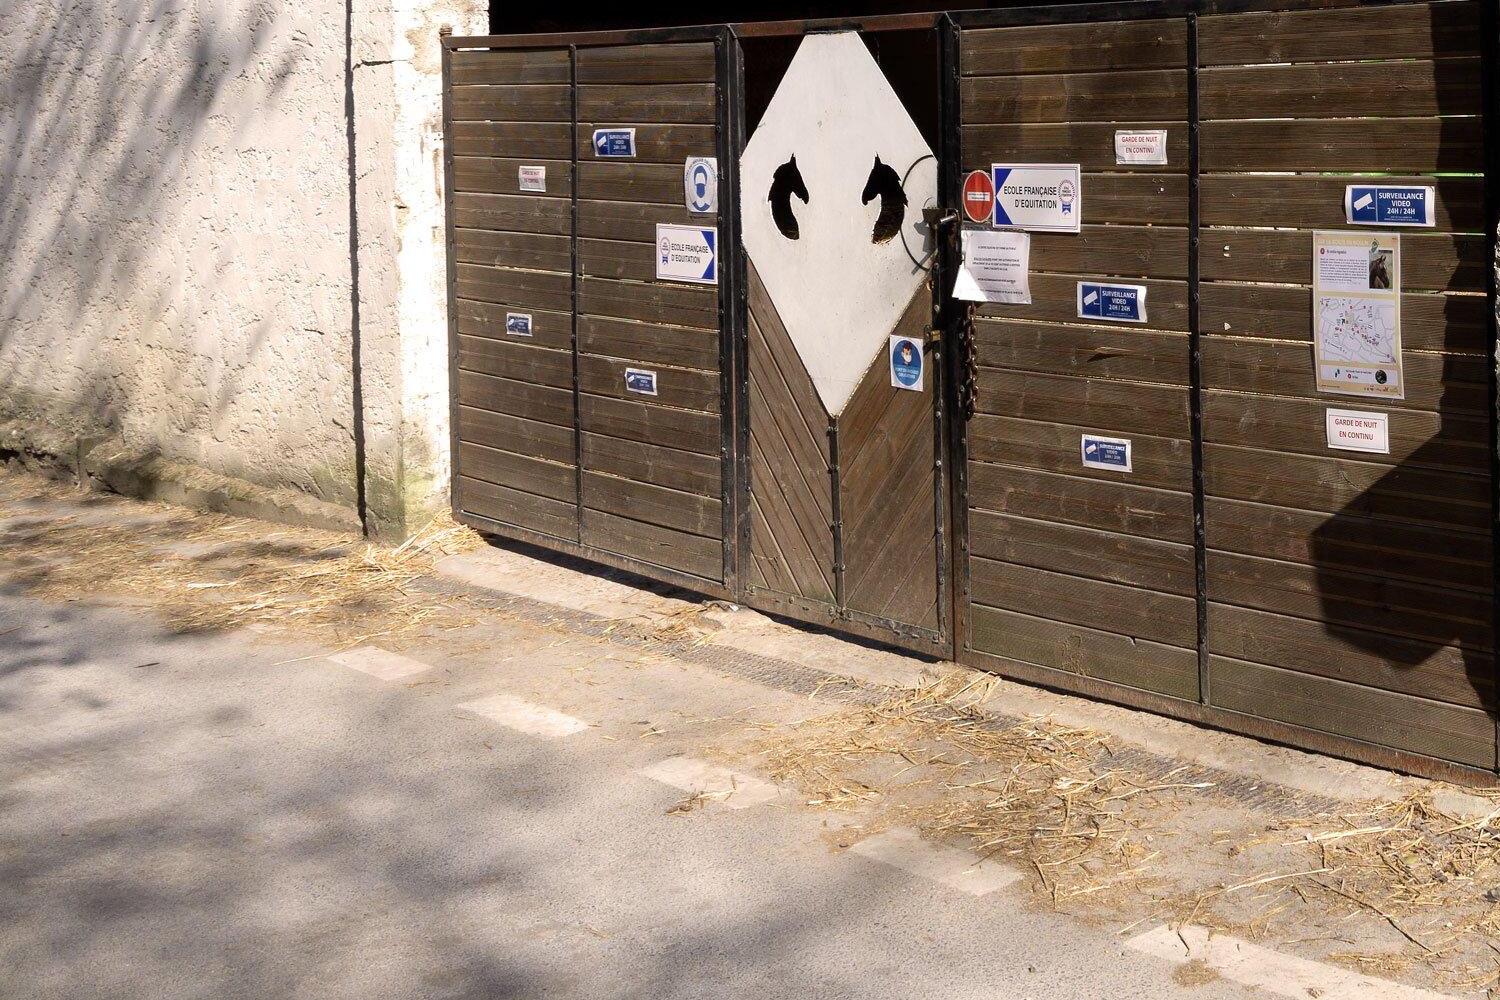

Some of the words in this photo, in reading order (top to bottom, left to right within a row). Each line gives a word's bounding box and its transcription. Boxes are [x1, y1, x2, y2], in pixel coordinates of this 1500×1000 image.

[1004, 186, 1024, 195] ECOLE
[1024, 186, 1057, 197] FRANÇAISE
[1378, 192, 1424, 200] SURVEILLANCE
[1014, 199, 1057, 208] D'EQUITATION
[671, 244, 684, 252] ECOLE
[685, 244, 708, 254] FRANÇAISE
[1102, 290, 1136, 298] SURVEILLANCE
[1335, 418, 1354, 426] GARDE
[1348, 432, 1374, 440] CONTINU
